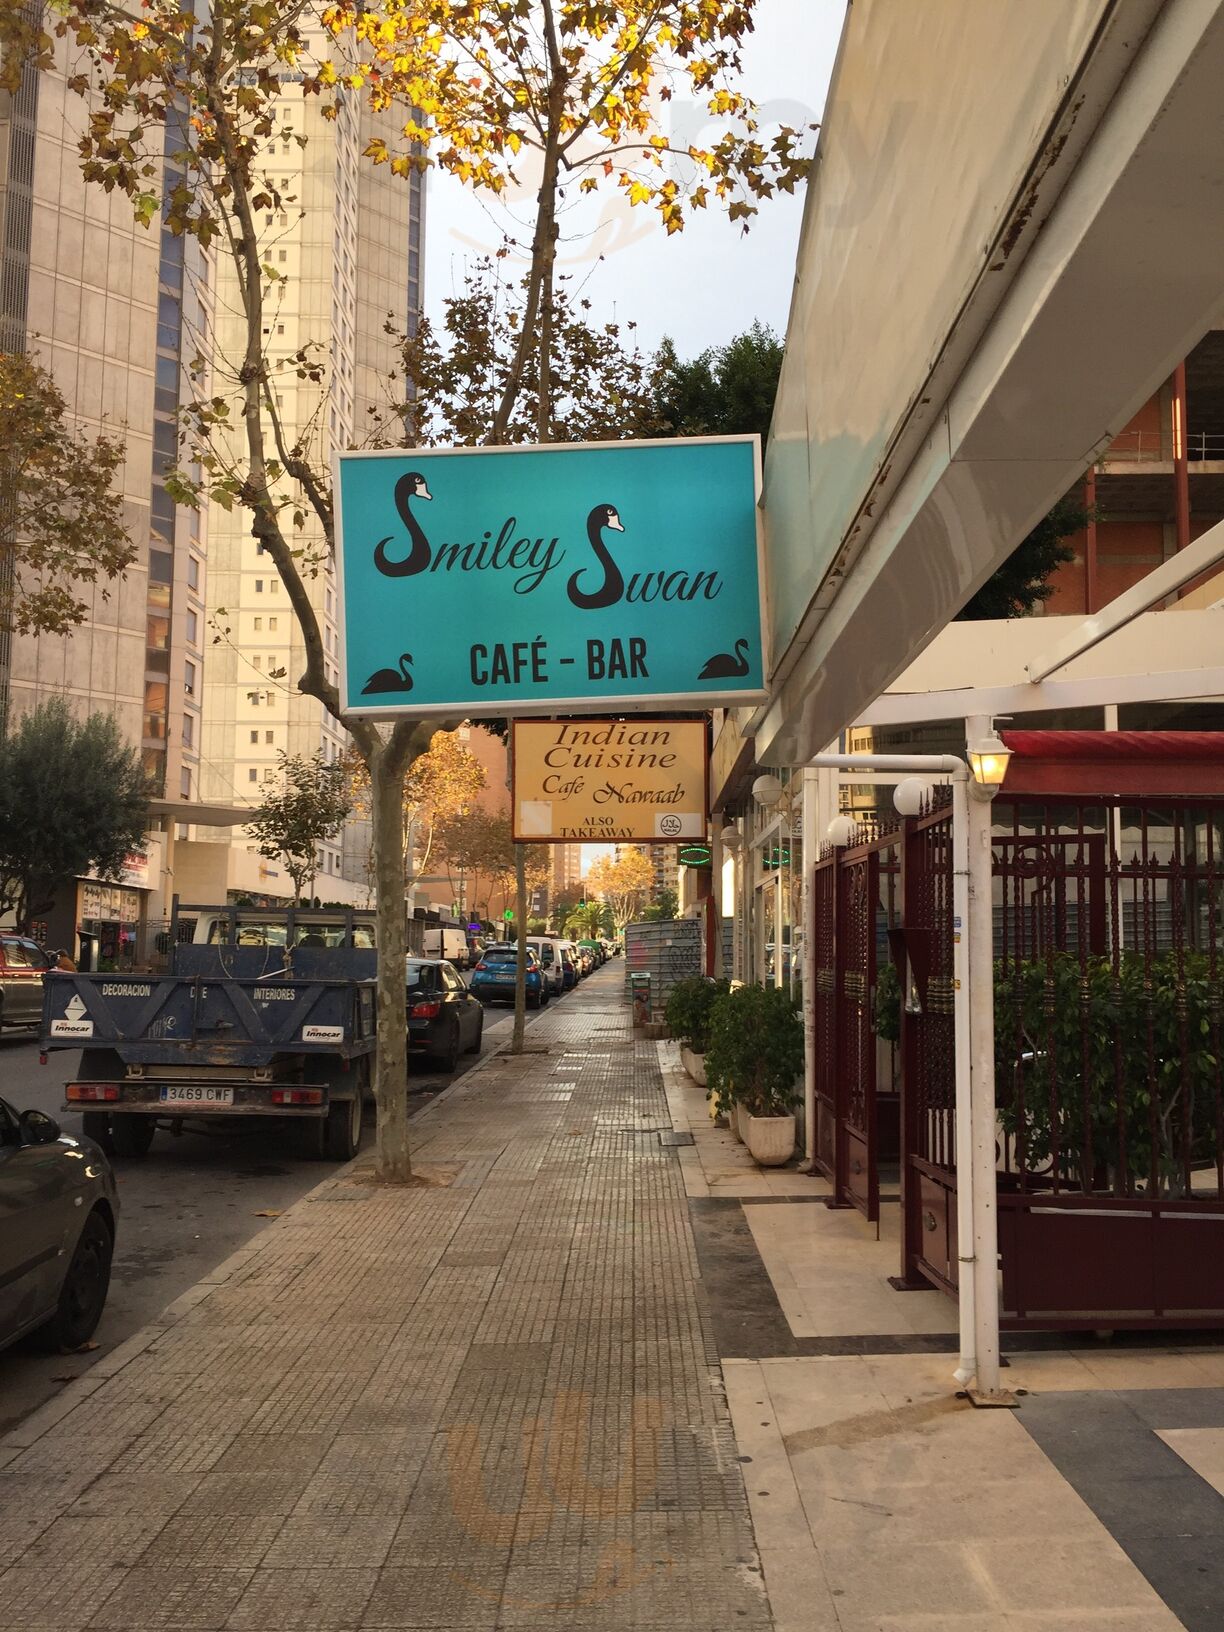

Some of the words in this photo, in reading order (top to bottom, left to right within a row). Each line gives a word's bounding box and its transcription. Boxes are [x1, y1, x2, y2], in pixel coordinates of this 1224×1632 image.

[373, 471, 566, 595] Smiley
[566, 503, 724, 610] Swan
[469, 634, 549, 686] CAFÉ
[586, 637, 650, 681] BAR
[553, 724, 671, 745] Indian
[543, 747, 678, 769] Cuisine
[542, 774, 585, 801] Cafe
[592, 781, 685, 805] Nawaab
[582, 816, 614, 826] ALSO
[560, 827, 635, 838] TAKEAWAY
[102, 983, 151, 997] DECORACION
[253, 987, 295, 1001] INTERIORES
[306, 1030, 341, 1038] Innocar
[169, 1088, 203, 1100] 3469
